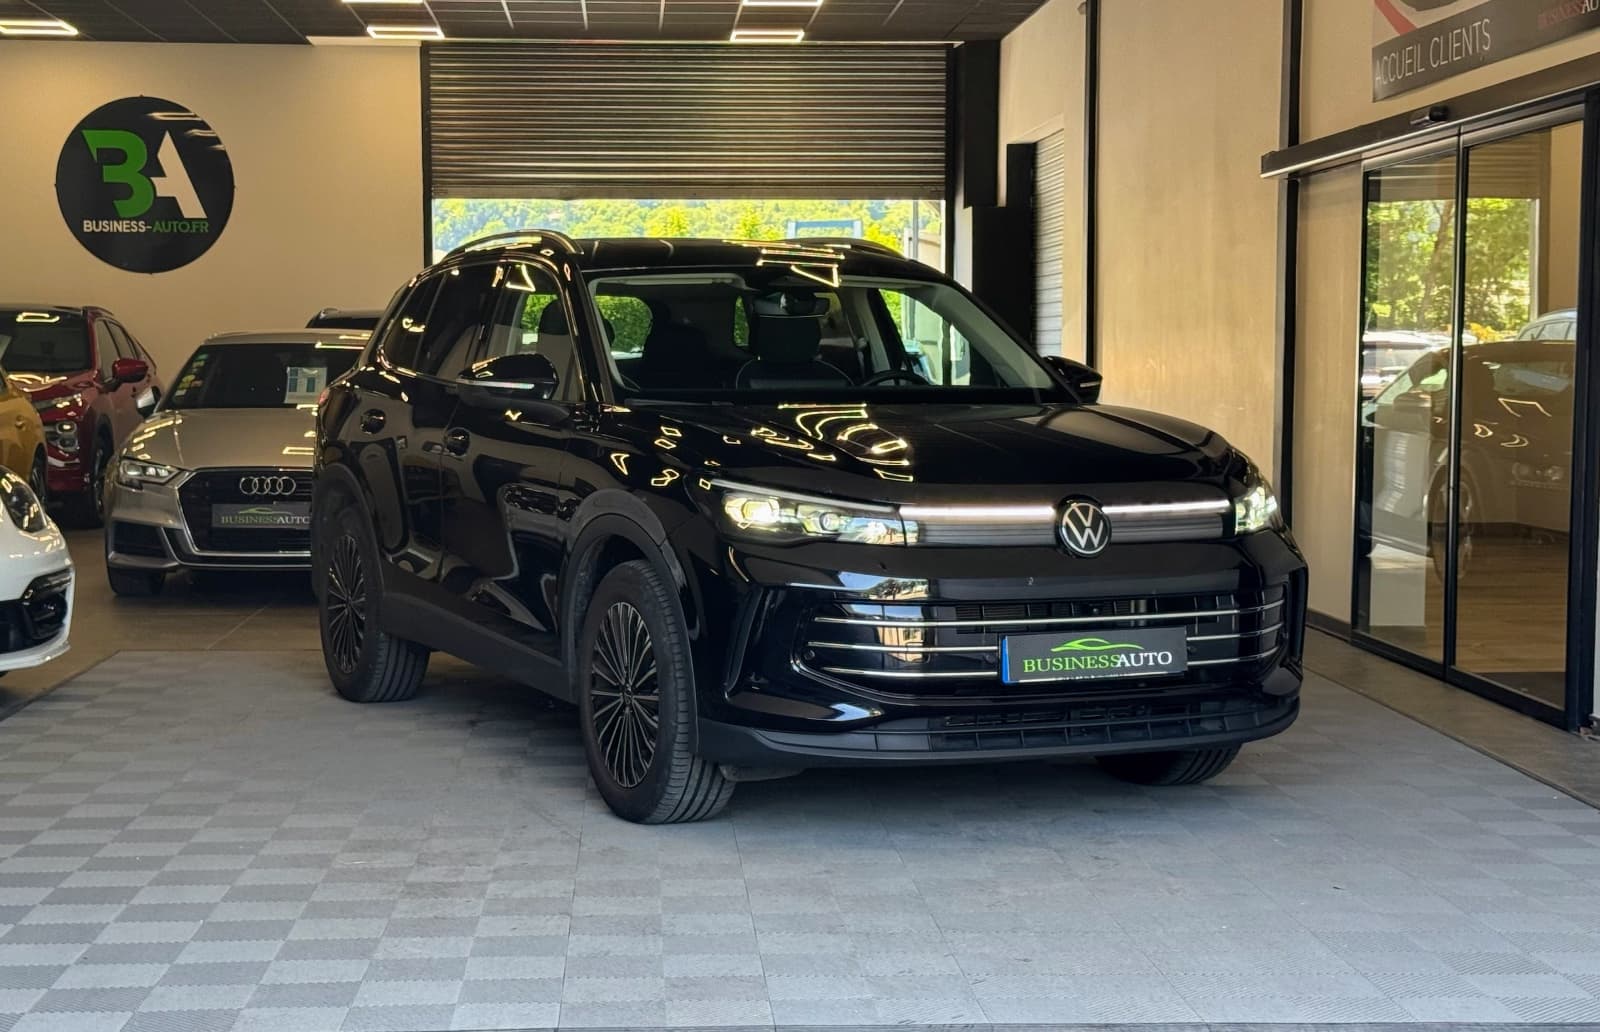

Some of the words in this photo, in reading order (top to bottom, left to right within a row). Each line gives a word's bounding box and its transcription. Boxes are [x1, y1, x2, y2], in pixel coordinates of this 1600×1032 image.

[1375, 45, 1425, 87] ACCUEIL
[1430, 19, 1491, 68] CLIENTS
[83, 220, 209, 233] BUSINESS-AUTO.FR
